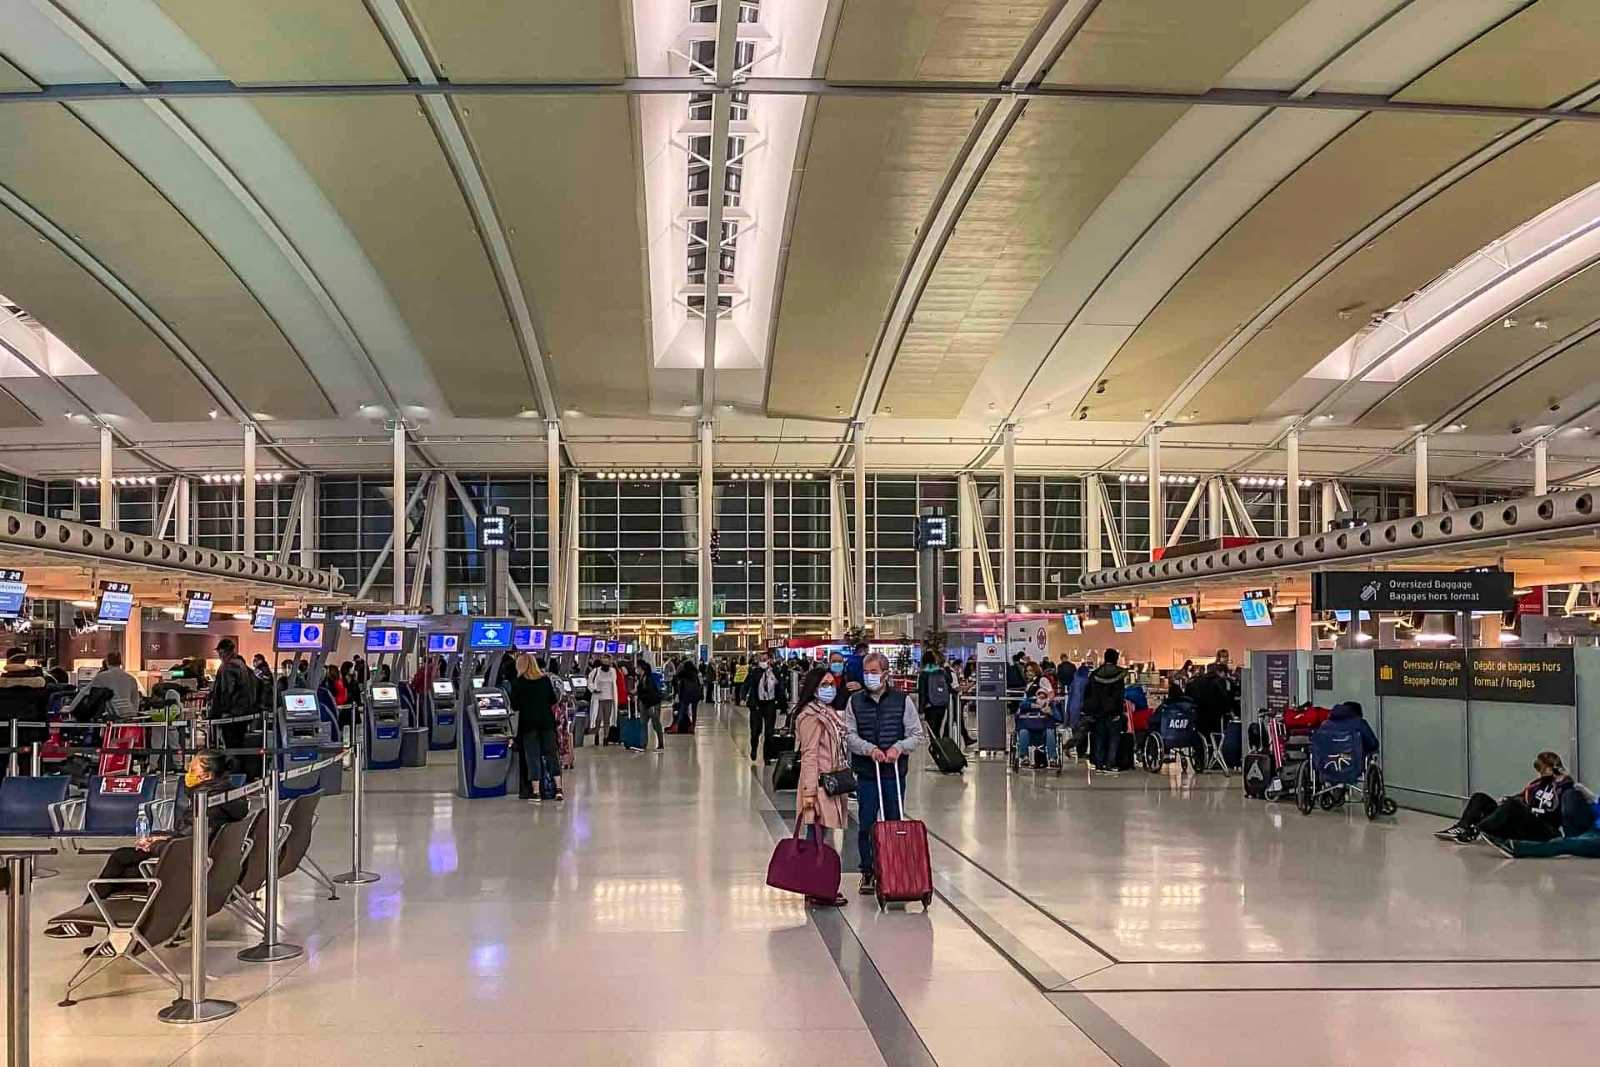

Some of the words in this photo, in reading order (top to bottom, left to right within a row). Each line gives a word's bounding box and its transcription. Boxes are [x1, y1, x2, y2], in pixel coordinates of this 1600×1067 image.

[483, 517, 503, 545] 2
[927, 518, 946, 545] 3
[1389, 579, 1432, 589] Oversized
[1434, 580, 1472, 590] Baggage
[1389, 592, 1427, 602] Bagages
[1428, 592, 1448, 600] hors
[1450, 592, 1480, 600] format
[1403, 660, 1433, 670] Oversized
[1440, 660, 1462, 672] Fragile
[1473, 660, 1496, 673] Dépôt
[1497, 661, 1507, 672] de
[1508, 661, 1541, 673] bagages
[1542, 661, 1561, 672] hors
[1403, 675, 1431, 688] Baggage
[1474, 676, 1499, 688] format
[1506, 677, 1537, 690] fragiles
